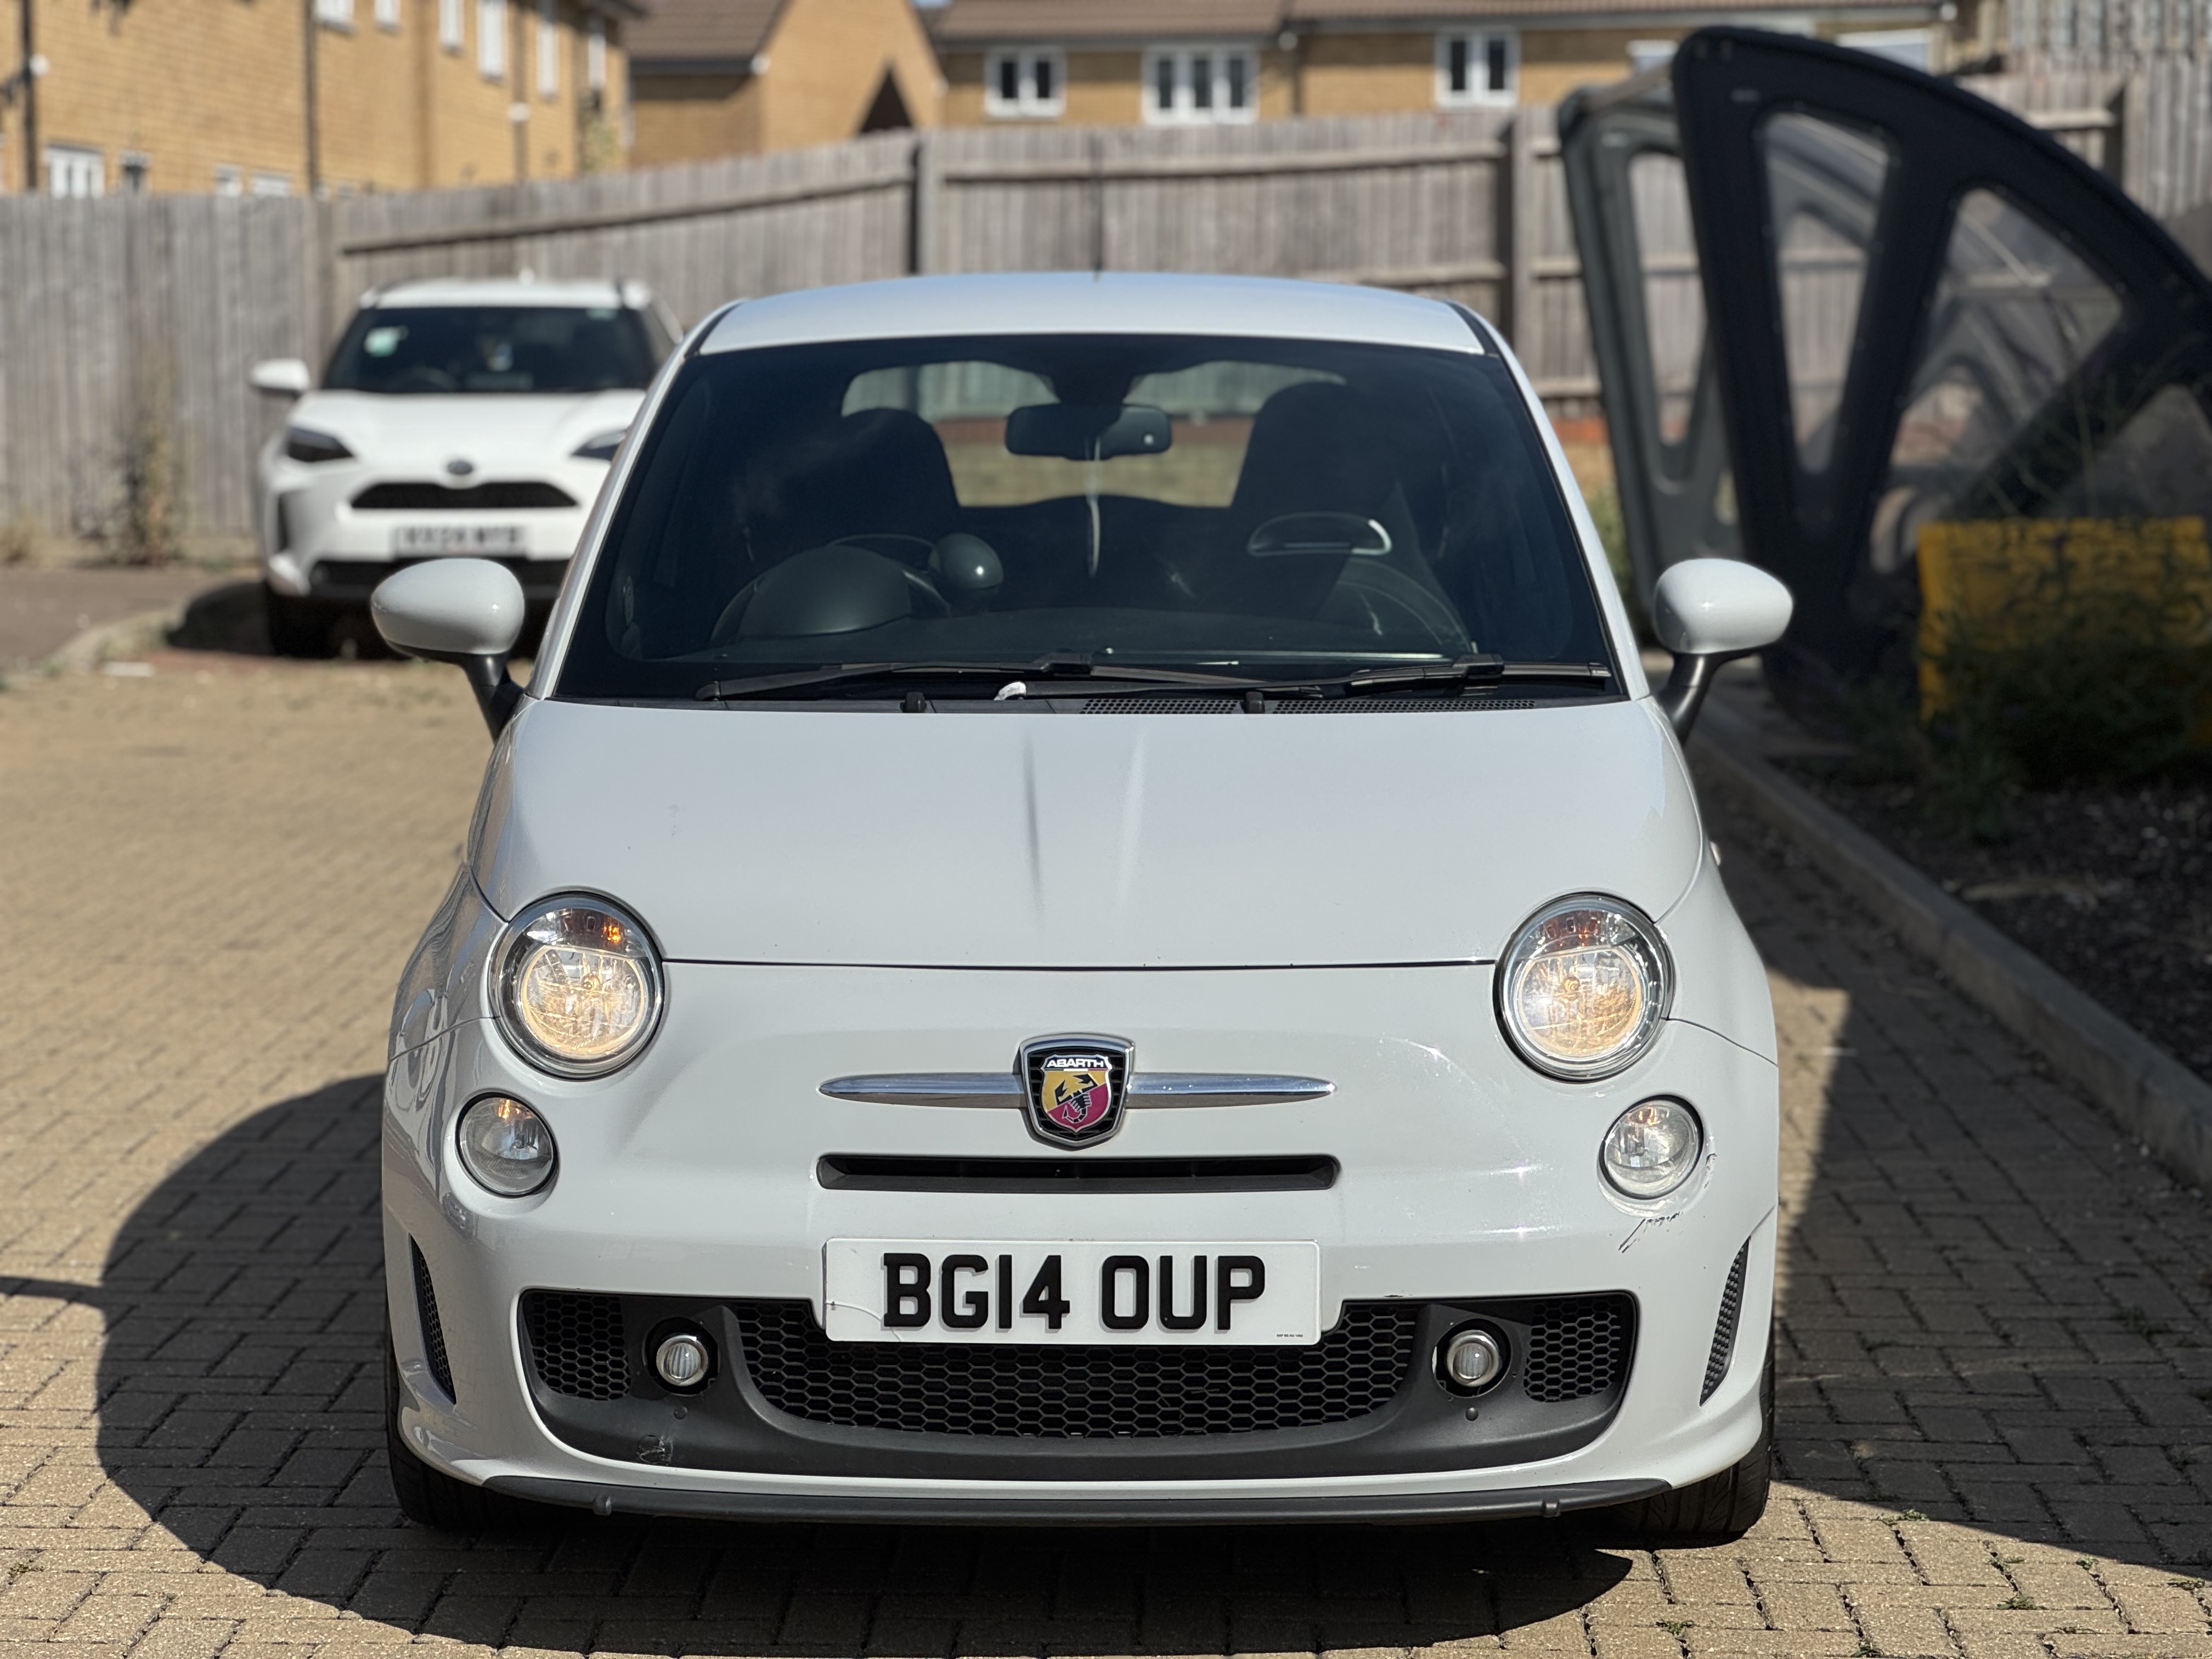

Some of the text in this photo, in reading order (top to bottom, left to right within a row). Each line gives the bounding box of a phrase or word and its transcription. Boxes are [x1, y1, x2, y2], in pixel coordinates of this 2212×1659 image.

[1046, 1058, 1104, 1068] ABARTH
[884, 1254, 1265, 1330] BG14 OUP
